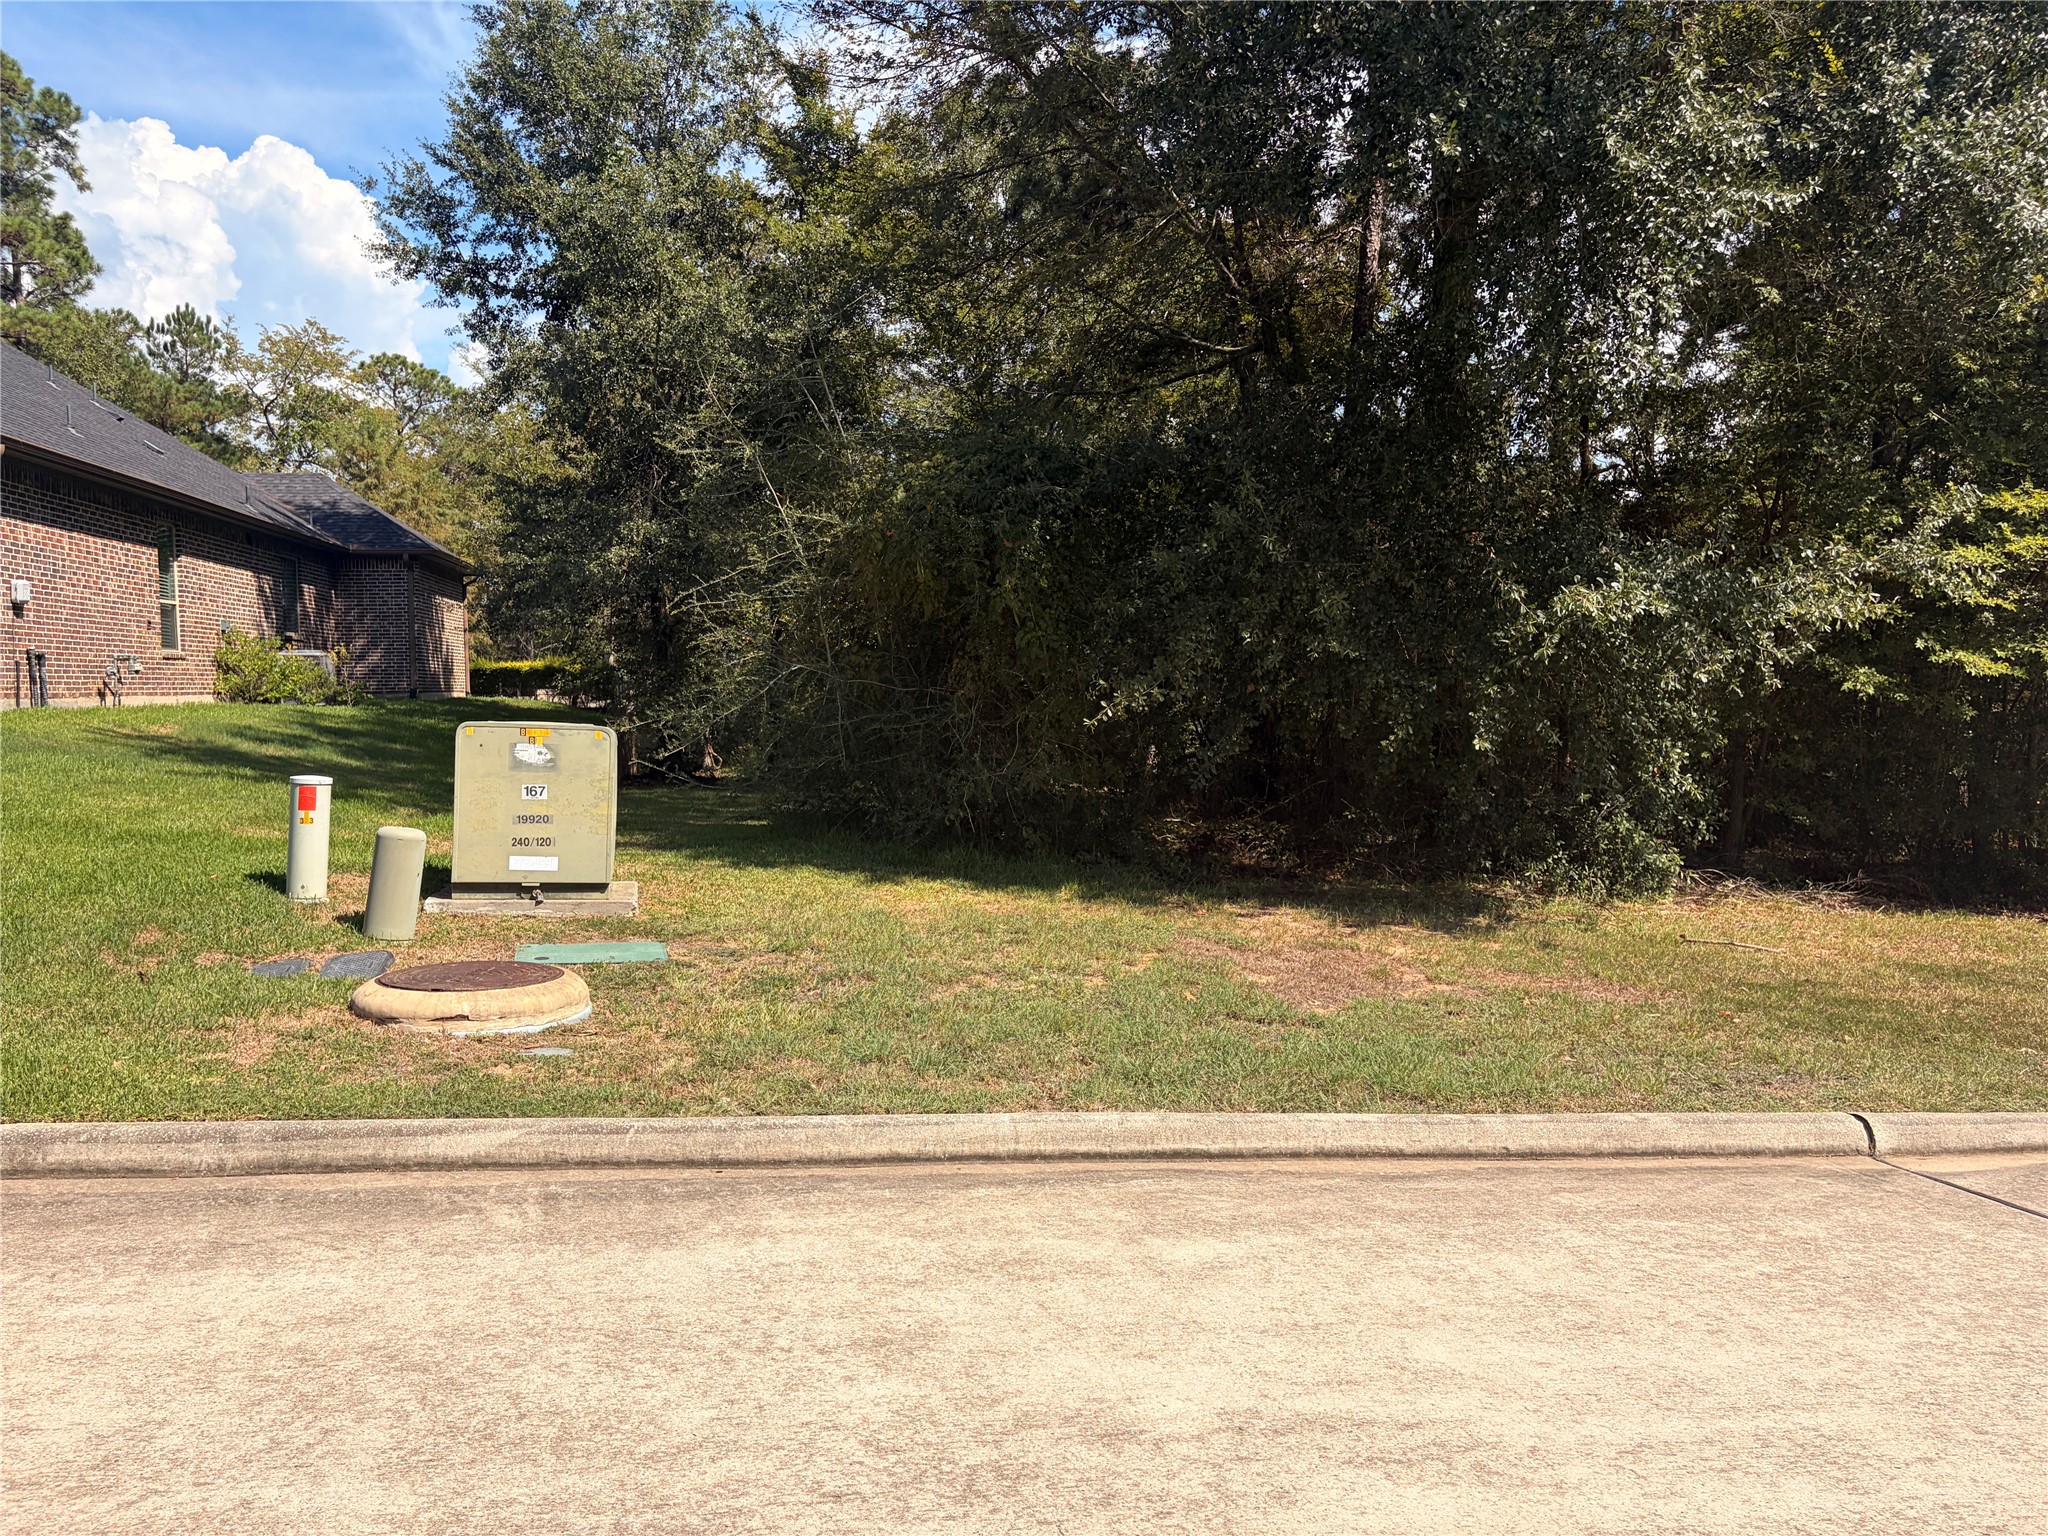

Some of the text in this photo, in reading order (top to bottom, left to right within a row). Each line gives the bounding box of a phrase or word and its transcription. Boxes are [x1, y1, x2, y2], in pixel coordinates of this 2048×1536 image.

[523, 785, 546, 796] 167
[516, 814, 549, 824] 19920
[511, 837, 551, 847] 240/120
